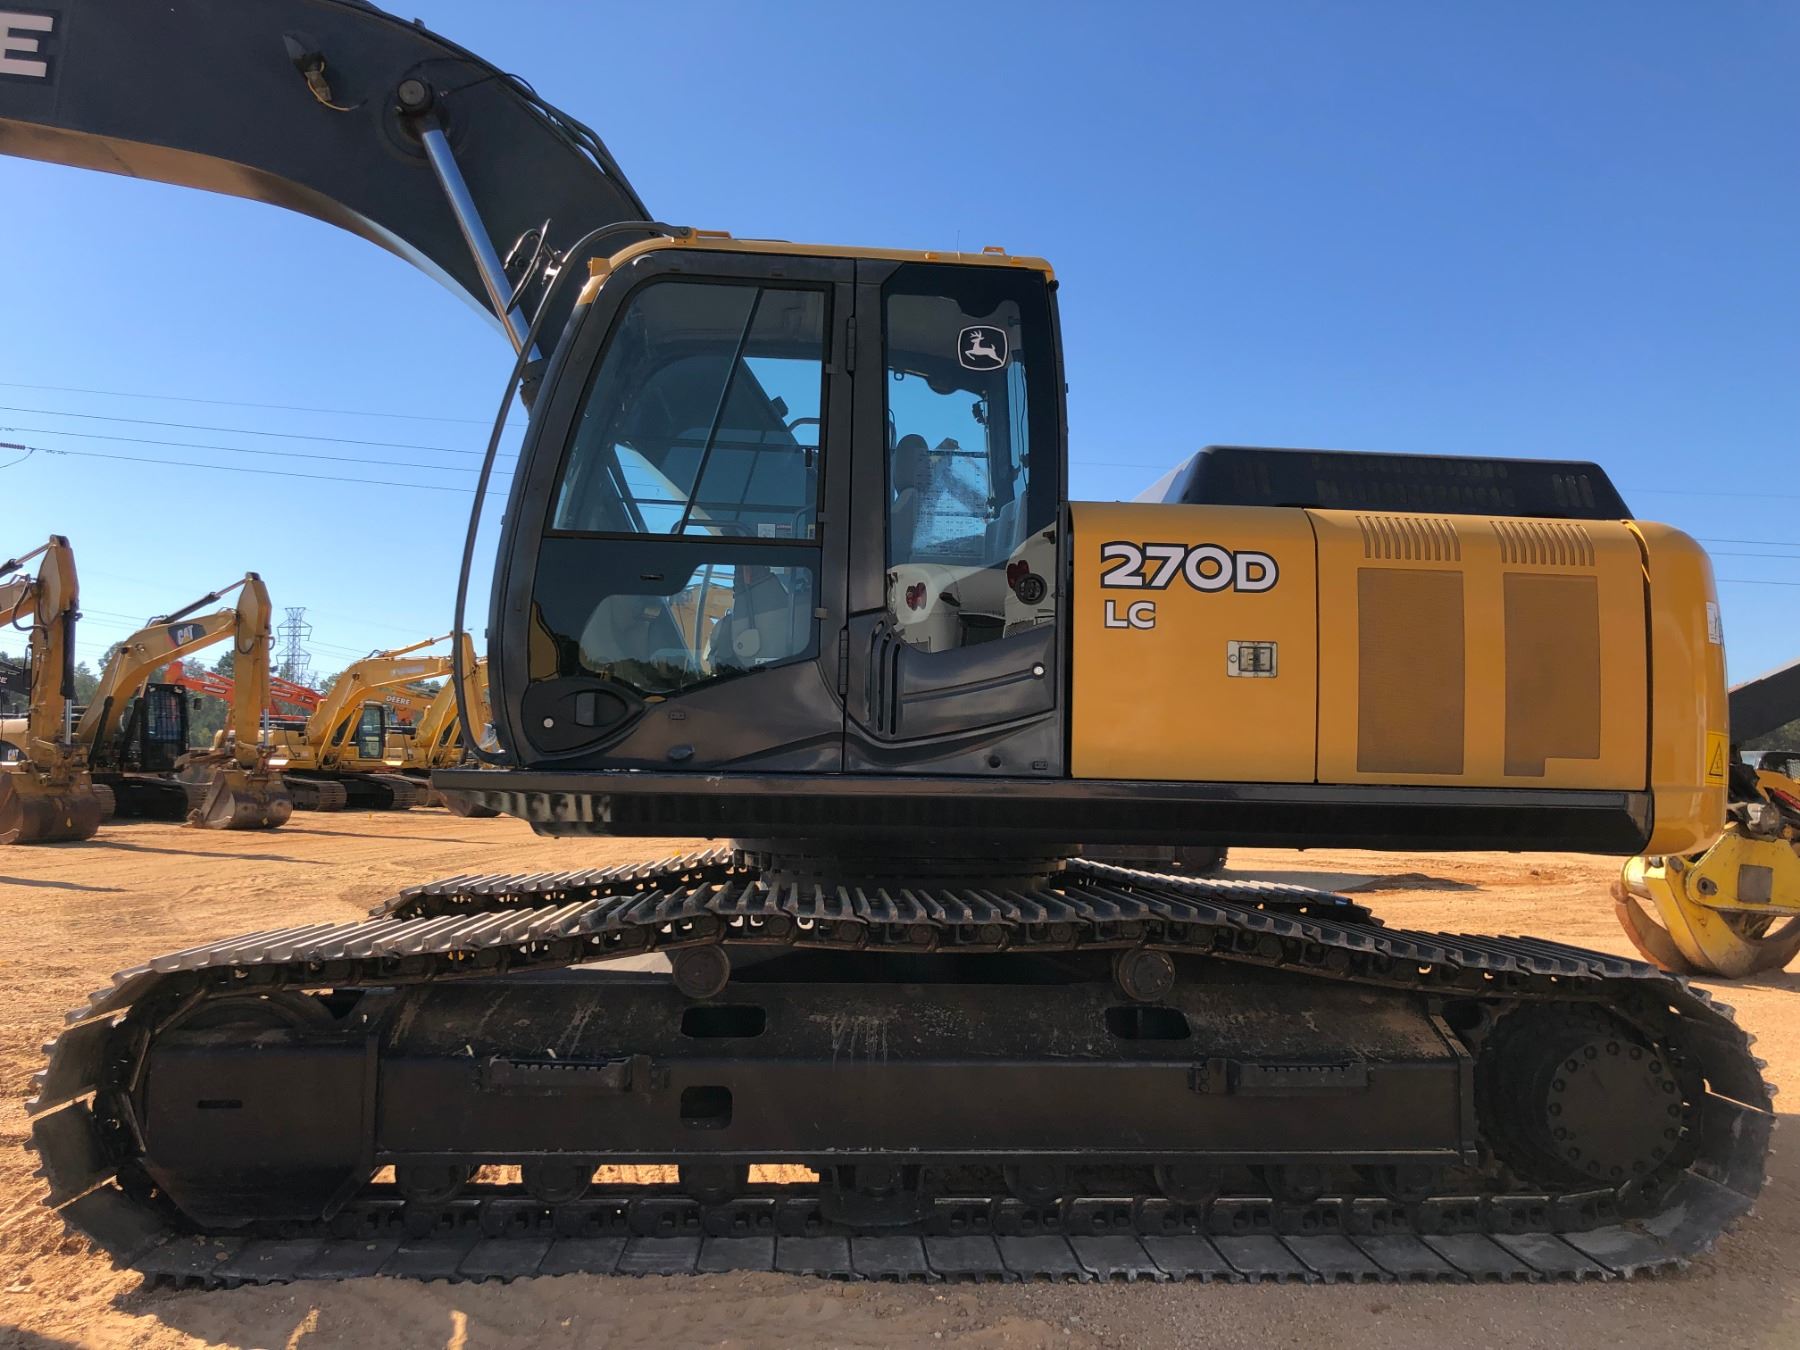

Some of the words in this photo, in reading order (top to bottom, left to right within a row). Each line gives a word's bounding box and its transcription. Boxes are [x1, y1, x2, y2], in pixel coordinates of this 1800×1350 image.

[1101, 541, 1279, 593] 270D
[1104, 600, 1156, 629] LC
[177, 625, 194, 646] CAT
[386, 695, 411, 705] DEERE
